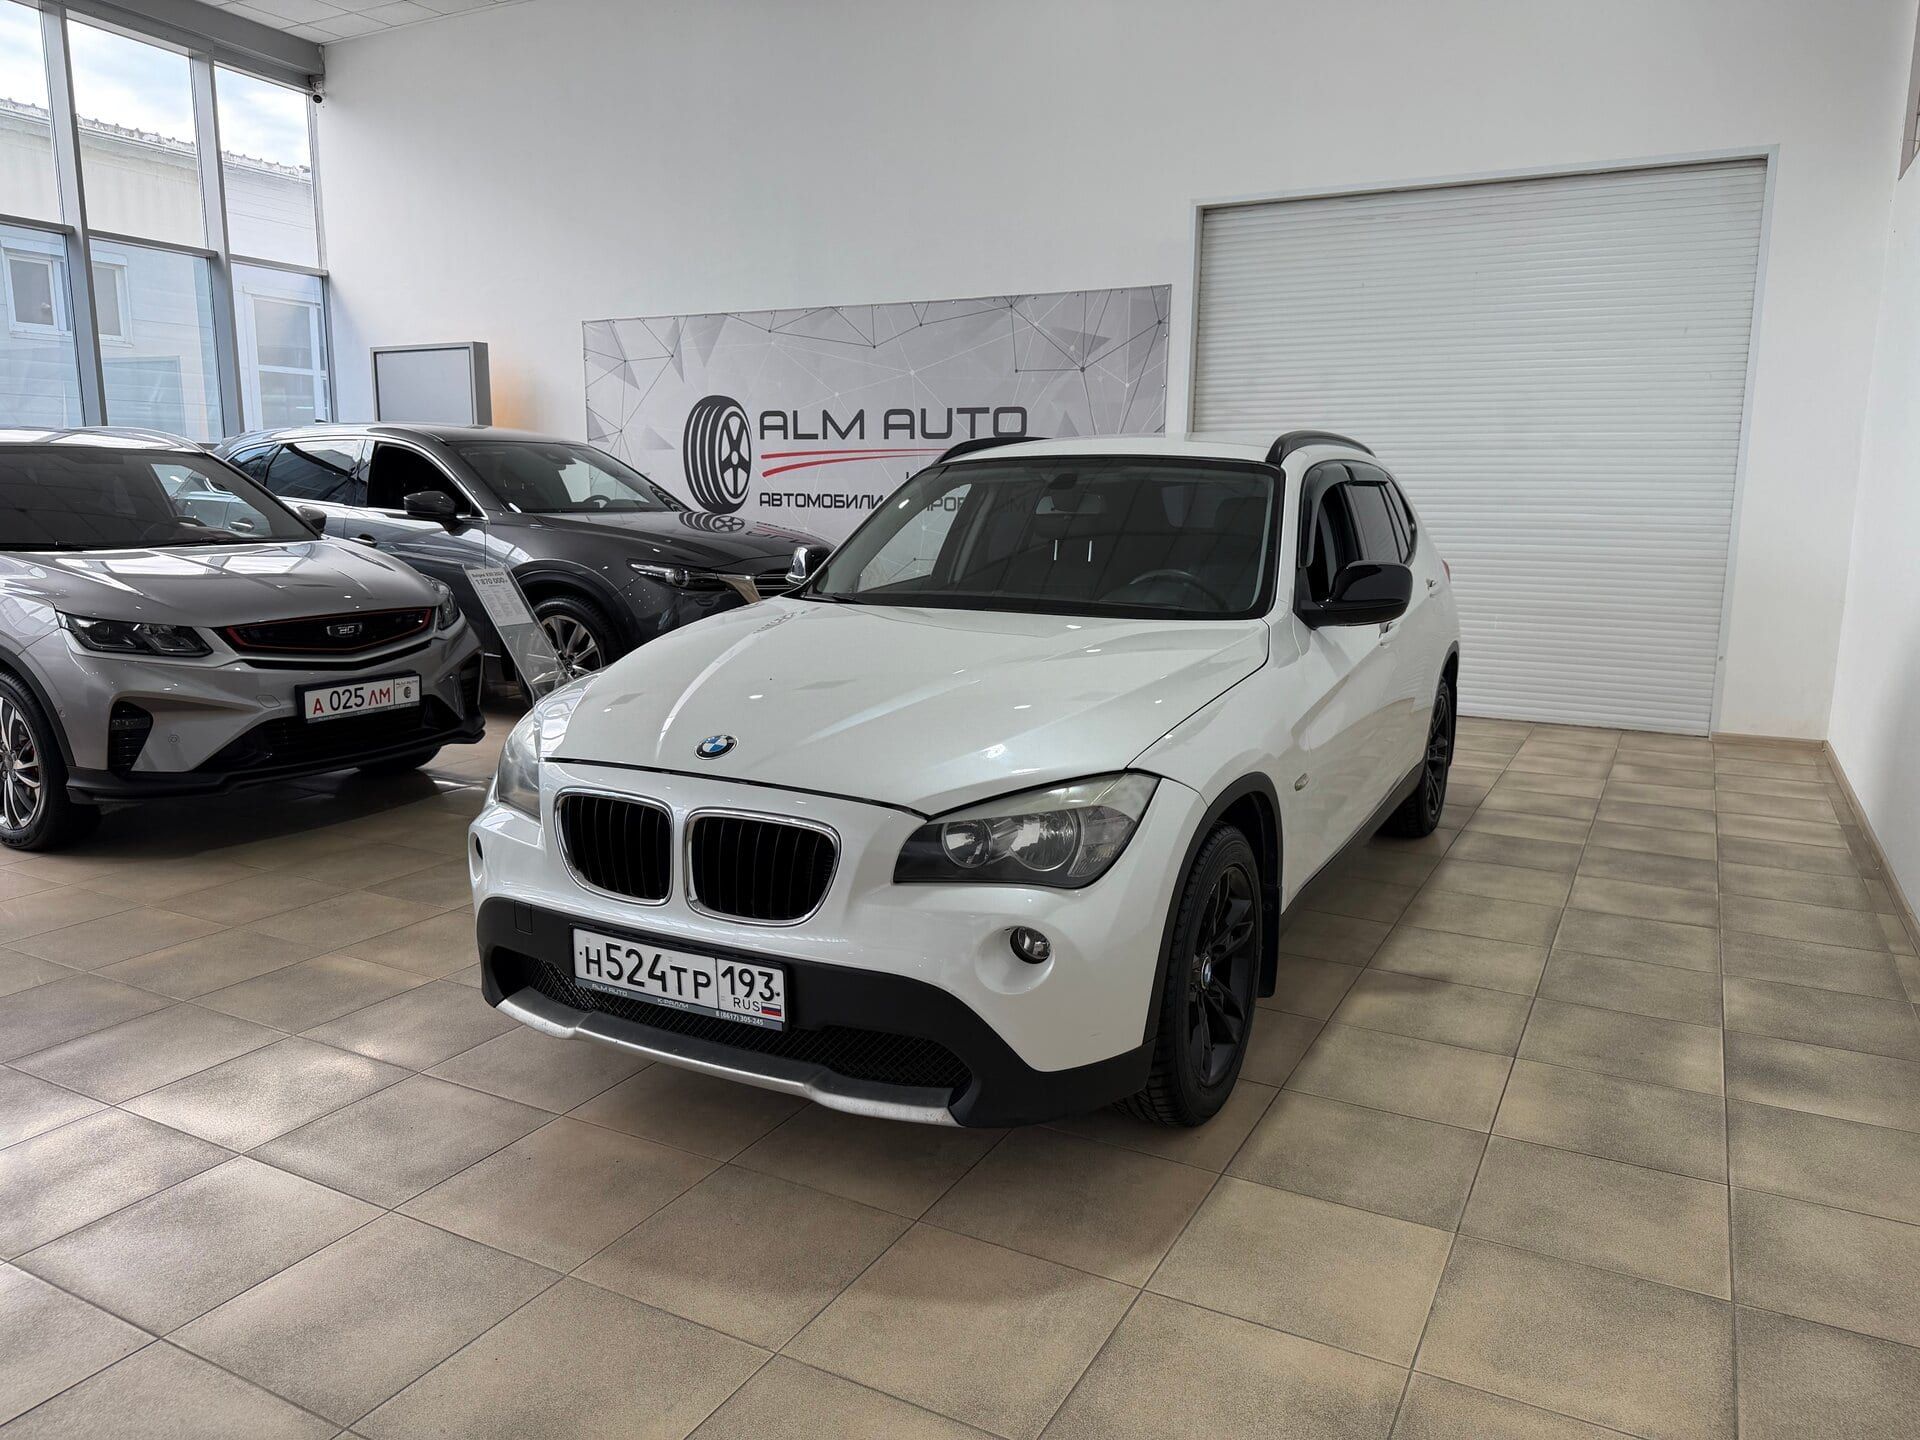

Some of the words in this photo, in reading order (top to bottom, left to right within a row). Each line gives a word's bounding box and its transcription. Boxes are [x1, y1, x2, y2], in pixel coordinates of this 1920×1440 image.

[759, 409, 865, 440] ALM
[883, 406, 1028, 440] AUTO
[329, 687, 365, 711] 025
[720, 965, 775, 1002] 193
[733, 997, 760, 1012] RUS
